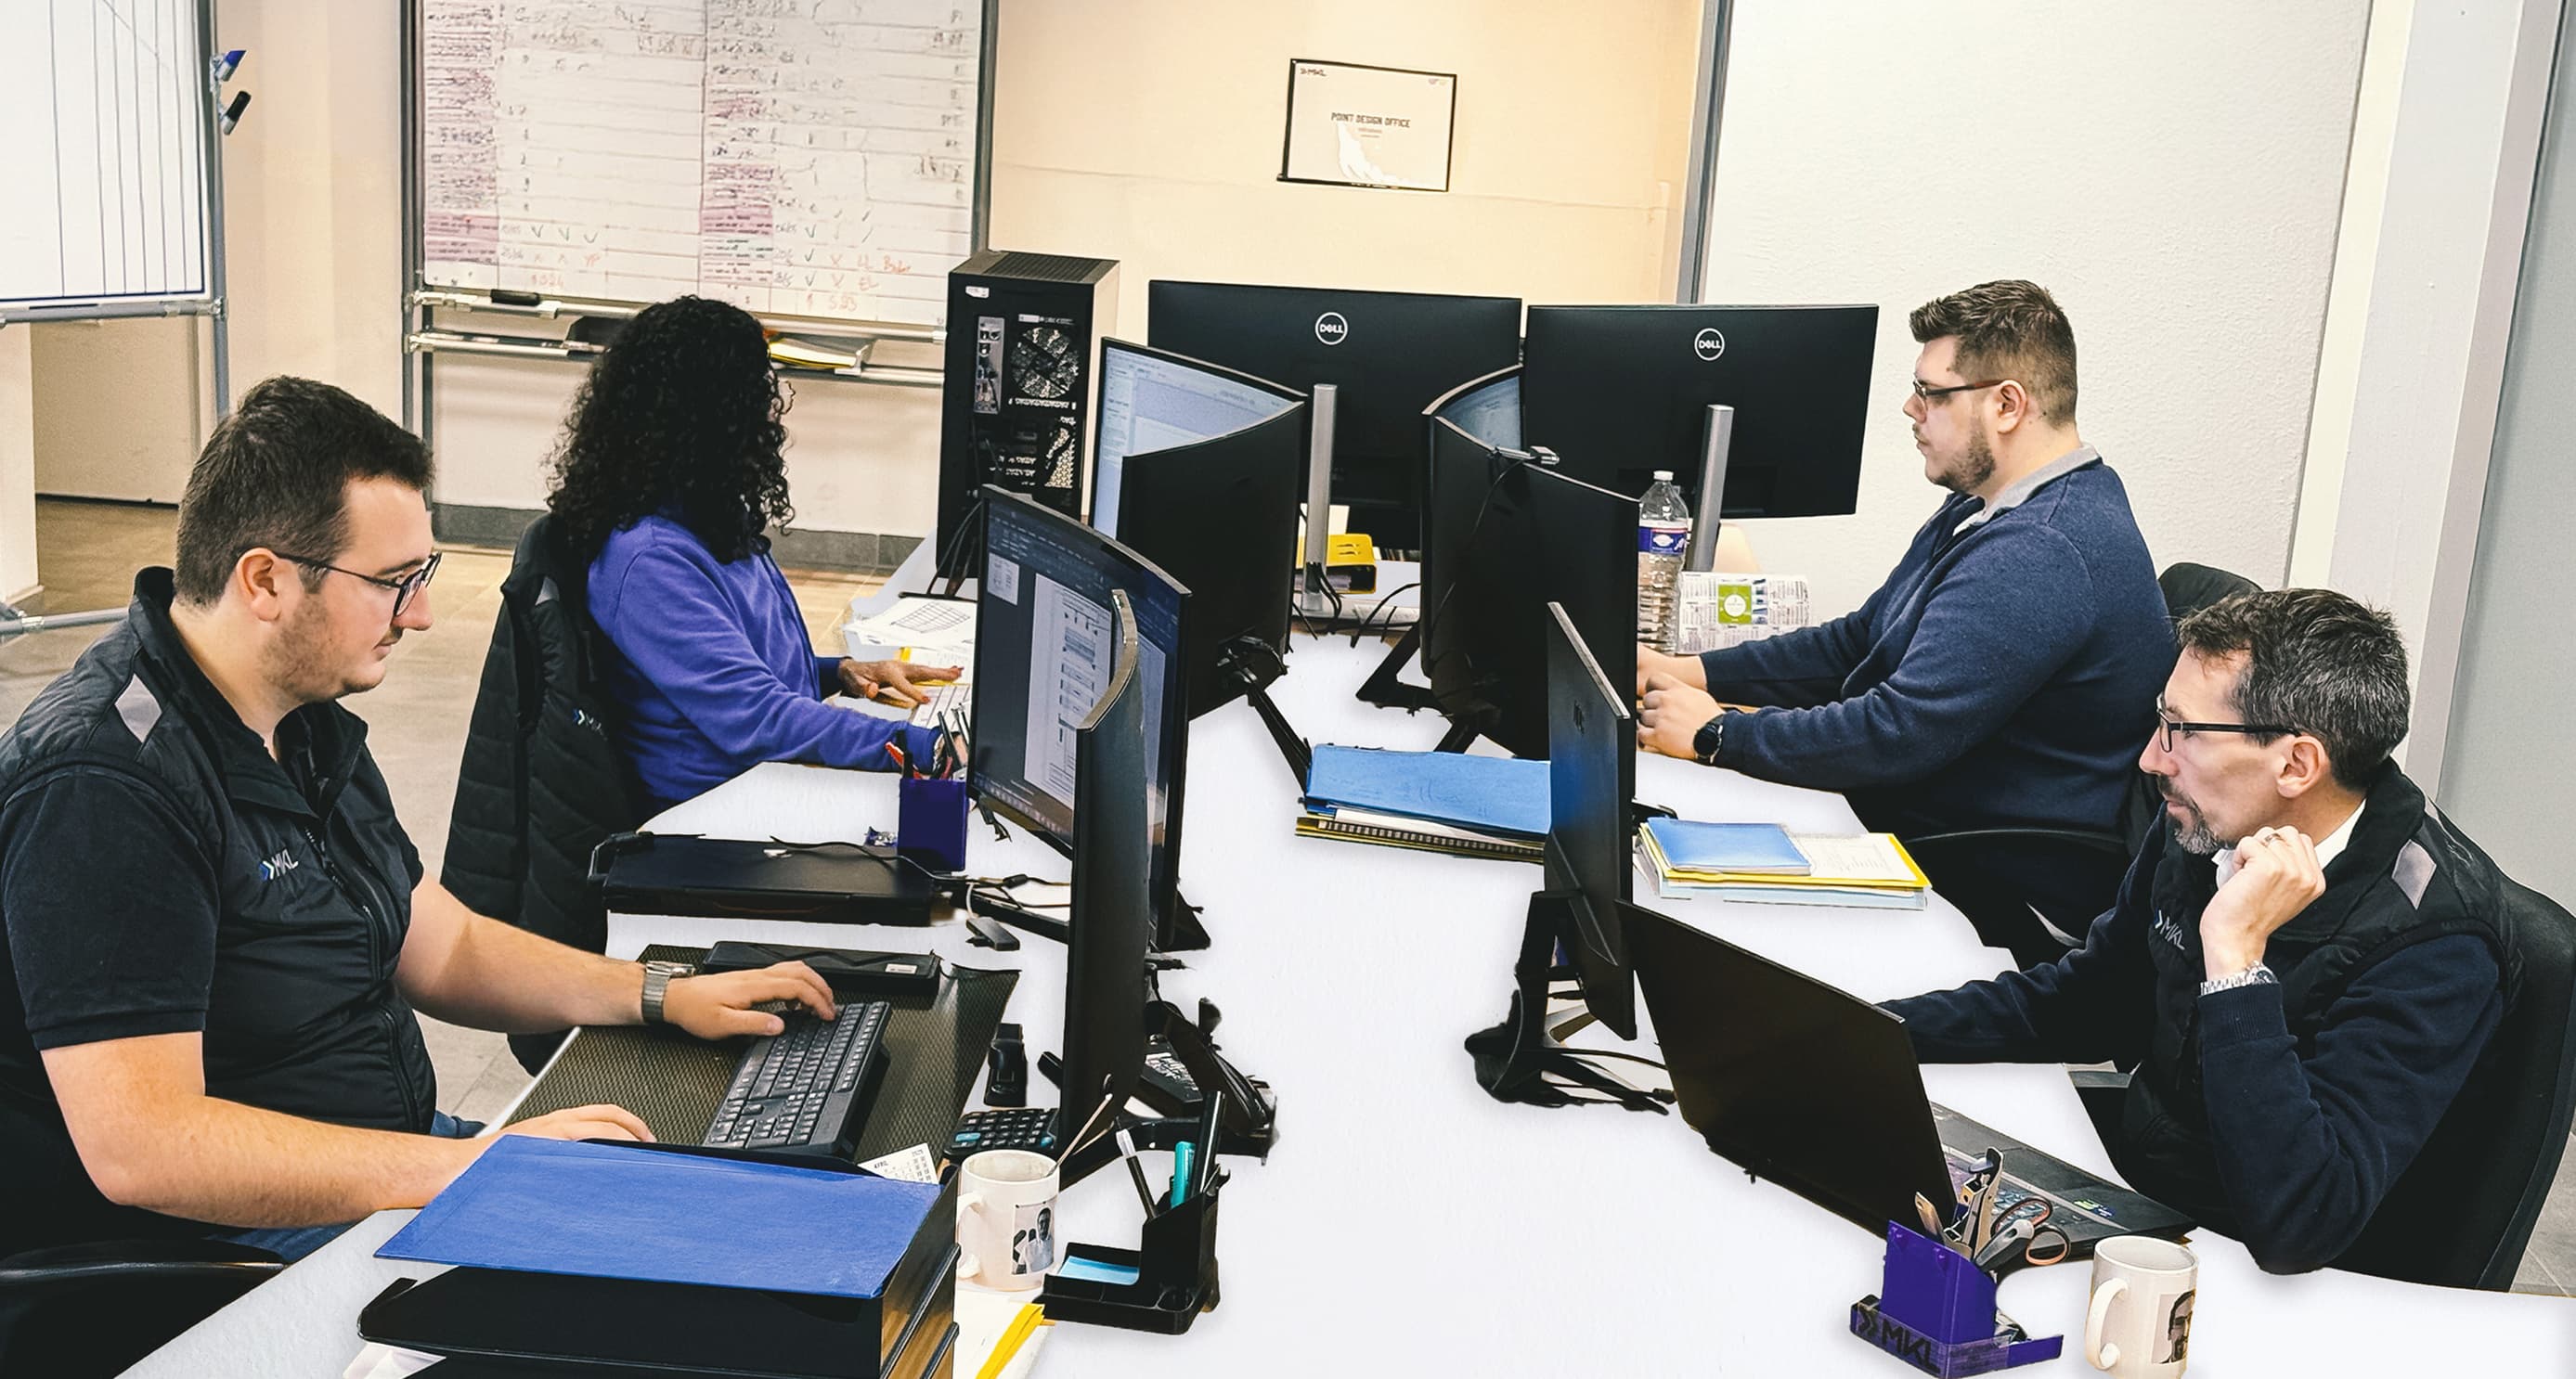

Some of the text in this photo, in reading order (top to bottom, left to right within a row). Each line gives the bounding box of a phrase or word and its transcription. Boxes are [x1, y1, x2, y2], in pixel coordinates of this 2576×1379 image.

[1331, 112, 1411, 128] POINT DESIGN OFFICE
[1320, 324, 1344, 333] DELL
[1699, 340, 1722, 349] DELL
[271, 849, 299, 877] MKL
[2159, 915, 2185, 950] MKL
[1881, 1318, 1941, 1374] MKL
